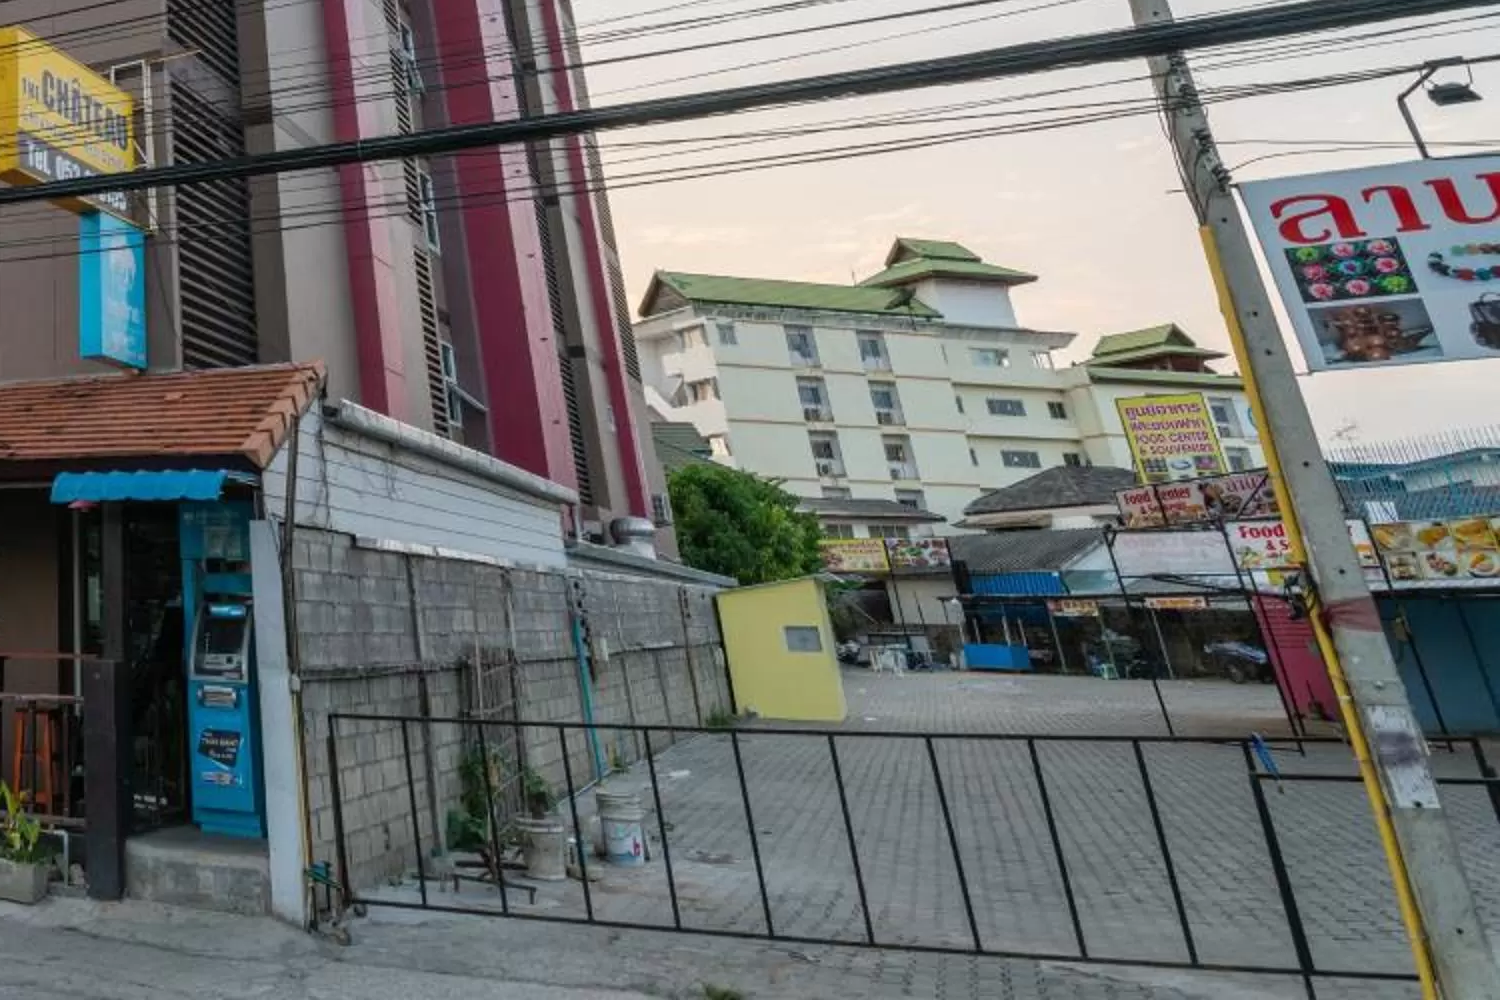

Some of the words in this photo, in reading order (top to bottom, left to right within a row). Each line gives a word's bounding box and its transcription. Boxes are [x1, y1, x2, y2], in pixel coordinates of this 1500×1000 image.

[1170, 431, 1209, 443] CENTER
[1124, 489, 1152, 505] Food
[1238, 523, 1286, 540] Food
[1265, 540, 1277, 551] &
